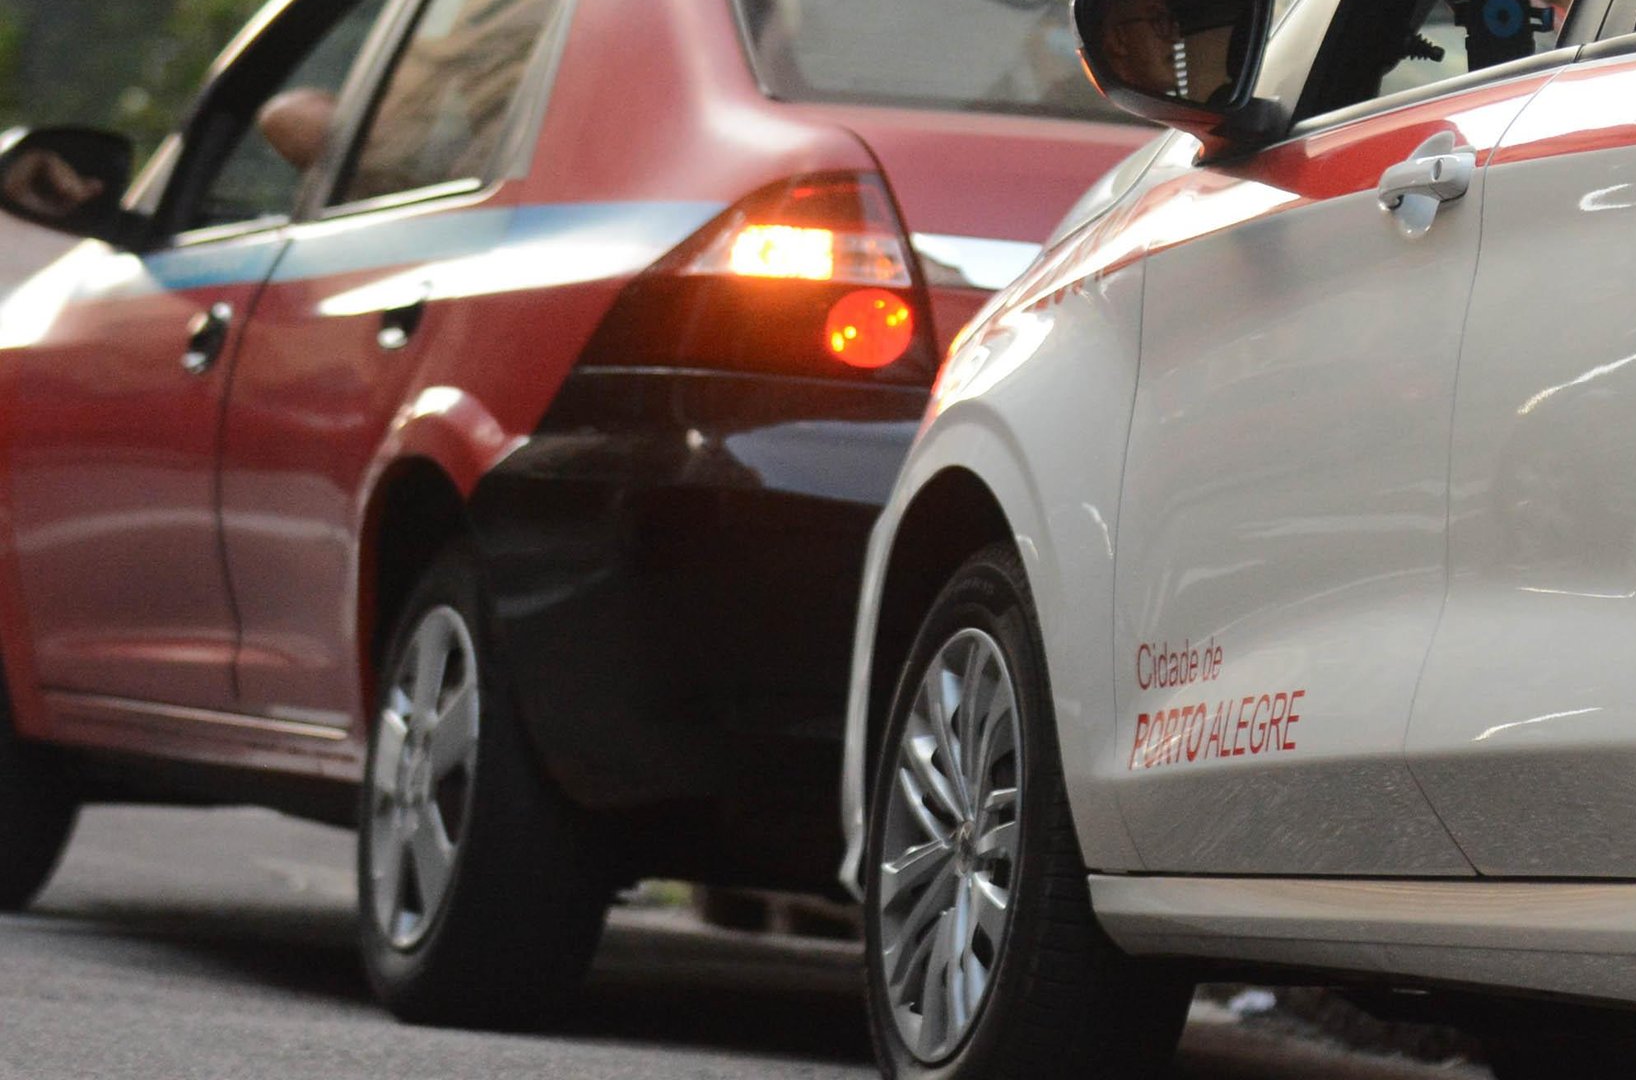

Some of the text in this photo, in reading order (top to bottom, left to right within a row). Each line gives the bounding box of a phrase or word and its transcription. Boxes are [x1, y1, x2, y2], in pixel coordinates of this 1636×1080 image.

[1136, 636, 1223, 690] Cidade de
[1128, 689, 1305, 770] PORTO ALEGRE
